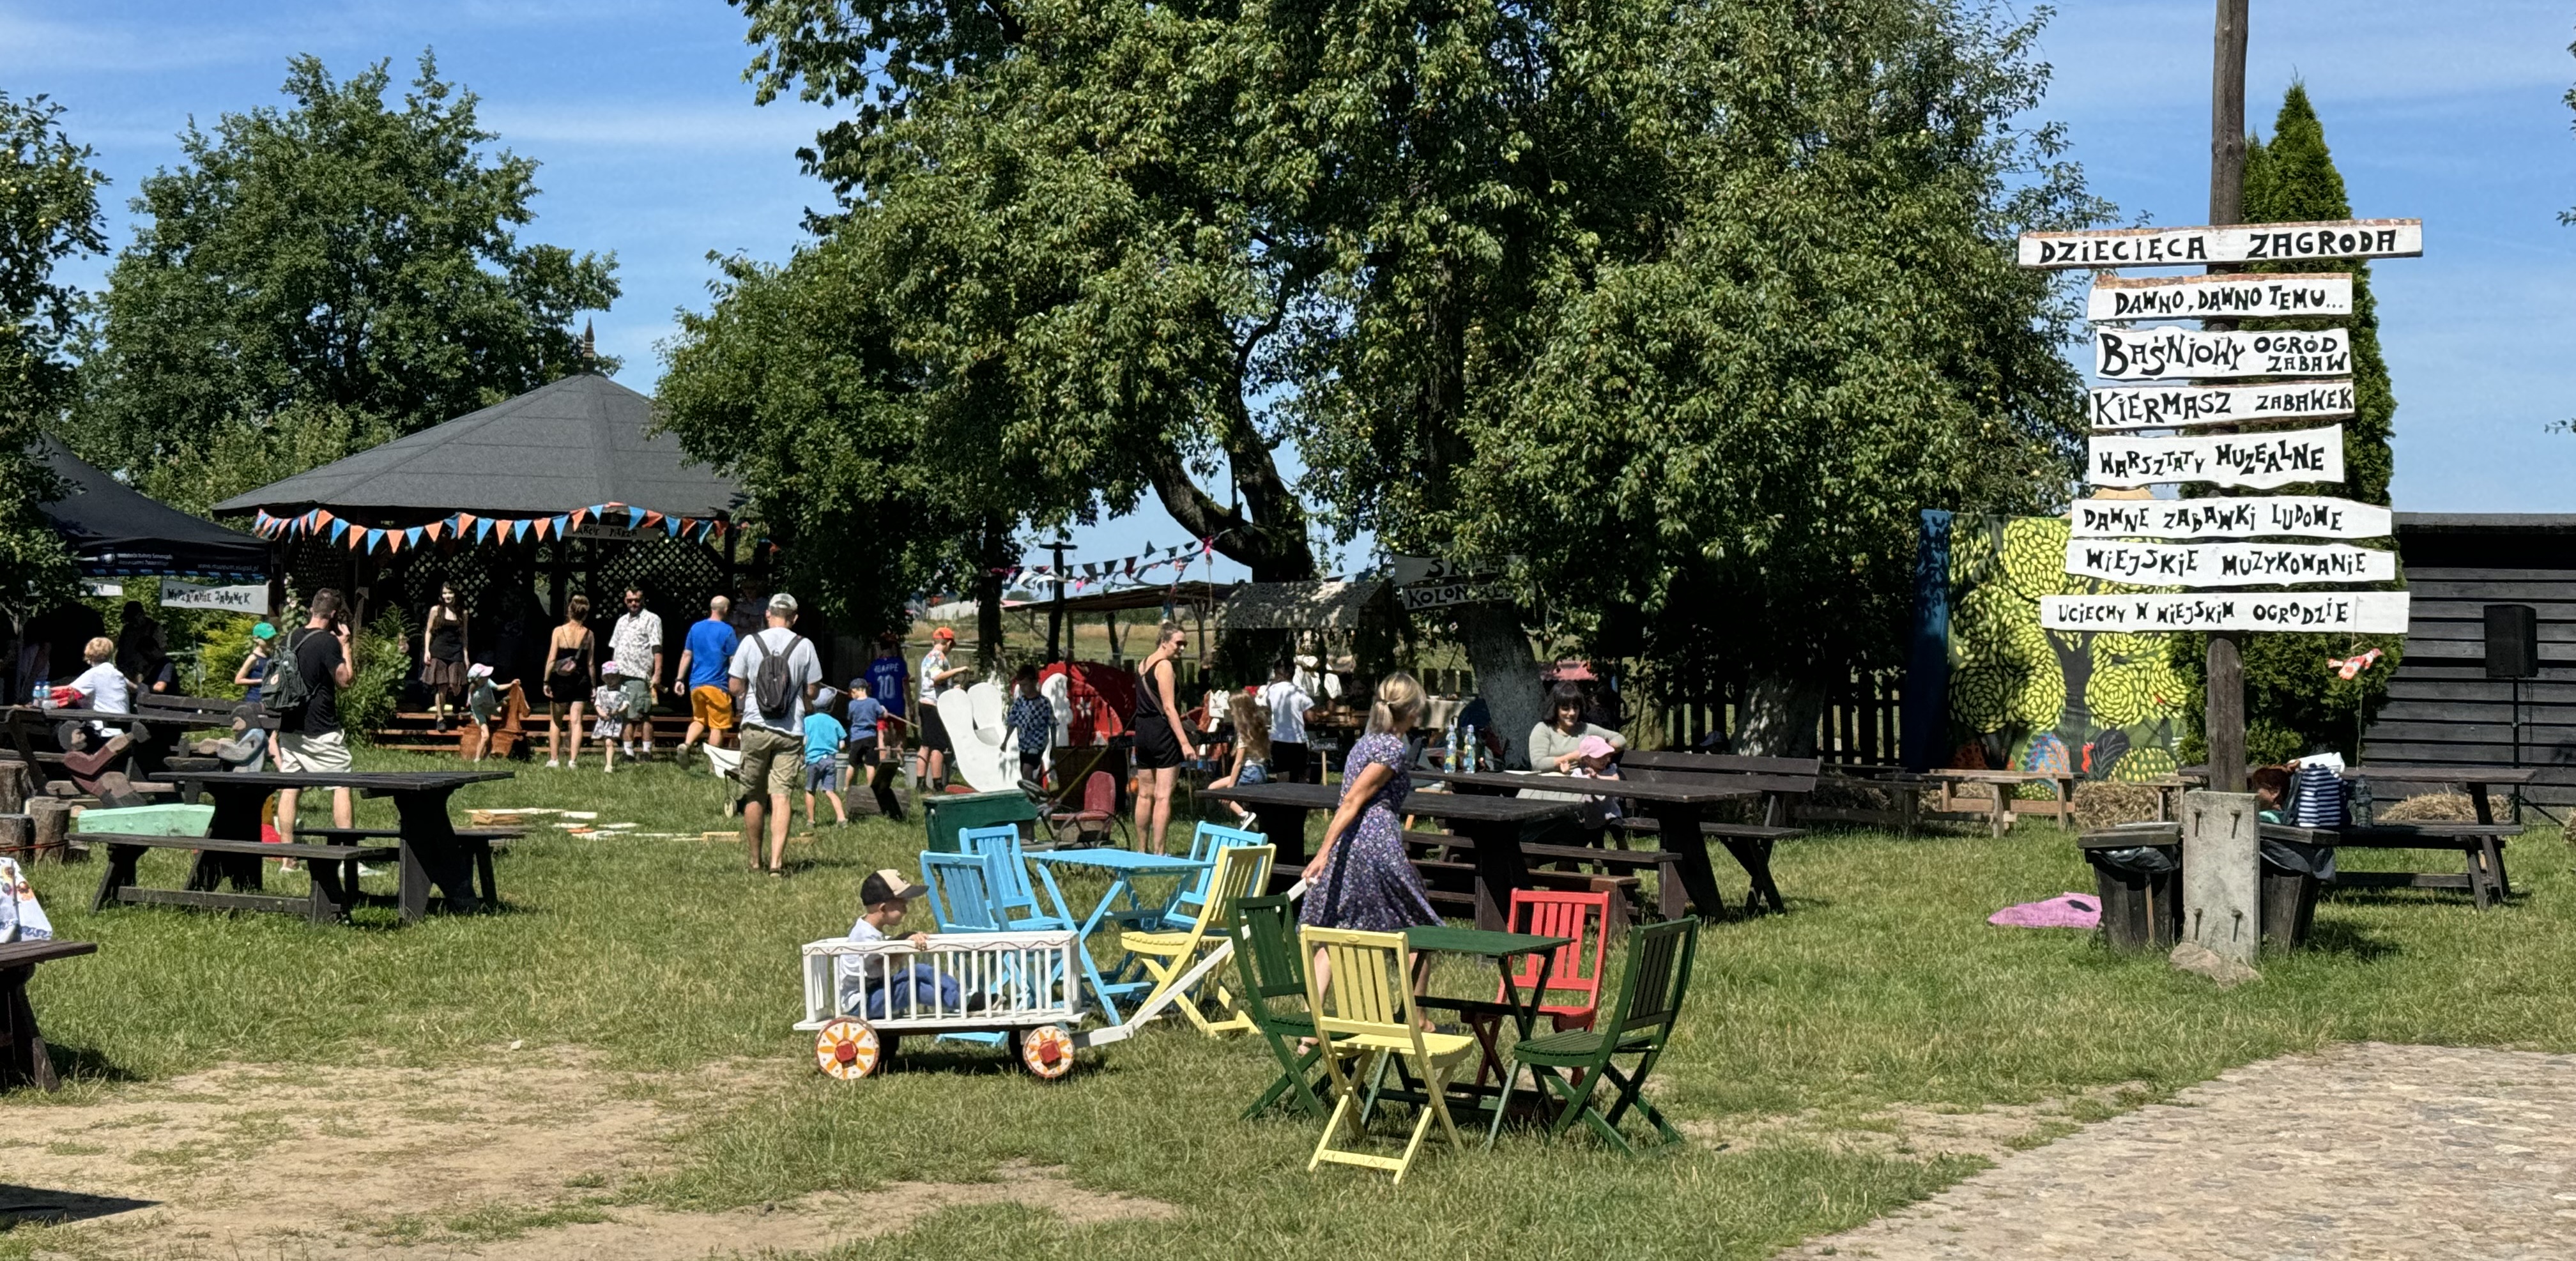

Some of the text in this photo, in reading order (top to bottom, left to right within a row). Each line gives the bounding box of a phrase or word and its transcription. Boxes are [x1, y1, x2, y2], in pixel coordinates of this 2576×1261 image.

[2039, 230, 2397, 264] DZIECIĘCA ZAGRODA
[2115, 286, 2344, 316] DAWNO, DAWNO TEMU...
[2100, 333, 2337, 376] BAŚNIOWY OGRÓD
[2266, 350, 2347, 372] ZABAW
[2093, 389, 2353, 423] KIERMASZ ZABAWEK
[2100, 440, 2324, 477] WARSZTATY MUZEALNE
[2084, 504, 2342, 532] DAWNE ZABAWKI LUDOWE
[2087, 549, 2365, 575] WIEJSKIE MUZYKOWANIE
[215, 591, 250, 605] ZABAWEK
[2059, 599, 2347, 624] UCIECHY W WIEJSKIM OGRODZIE
[877, 675, 895, 699] 10
